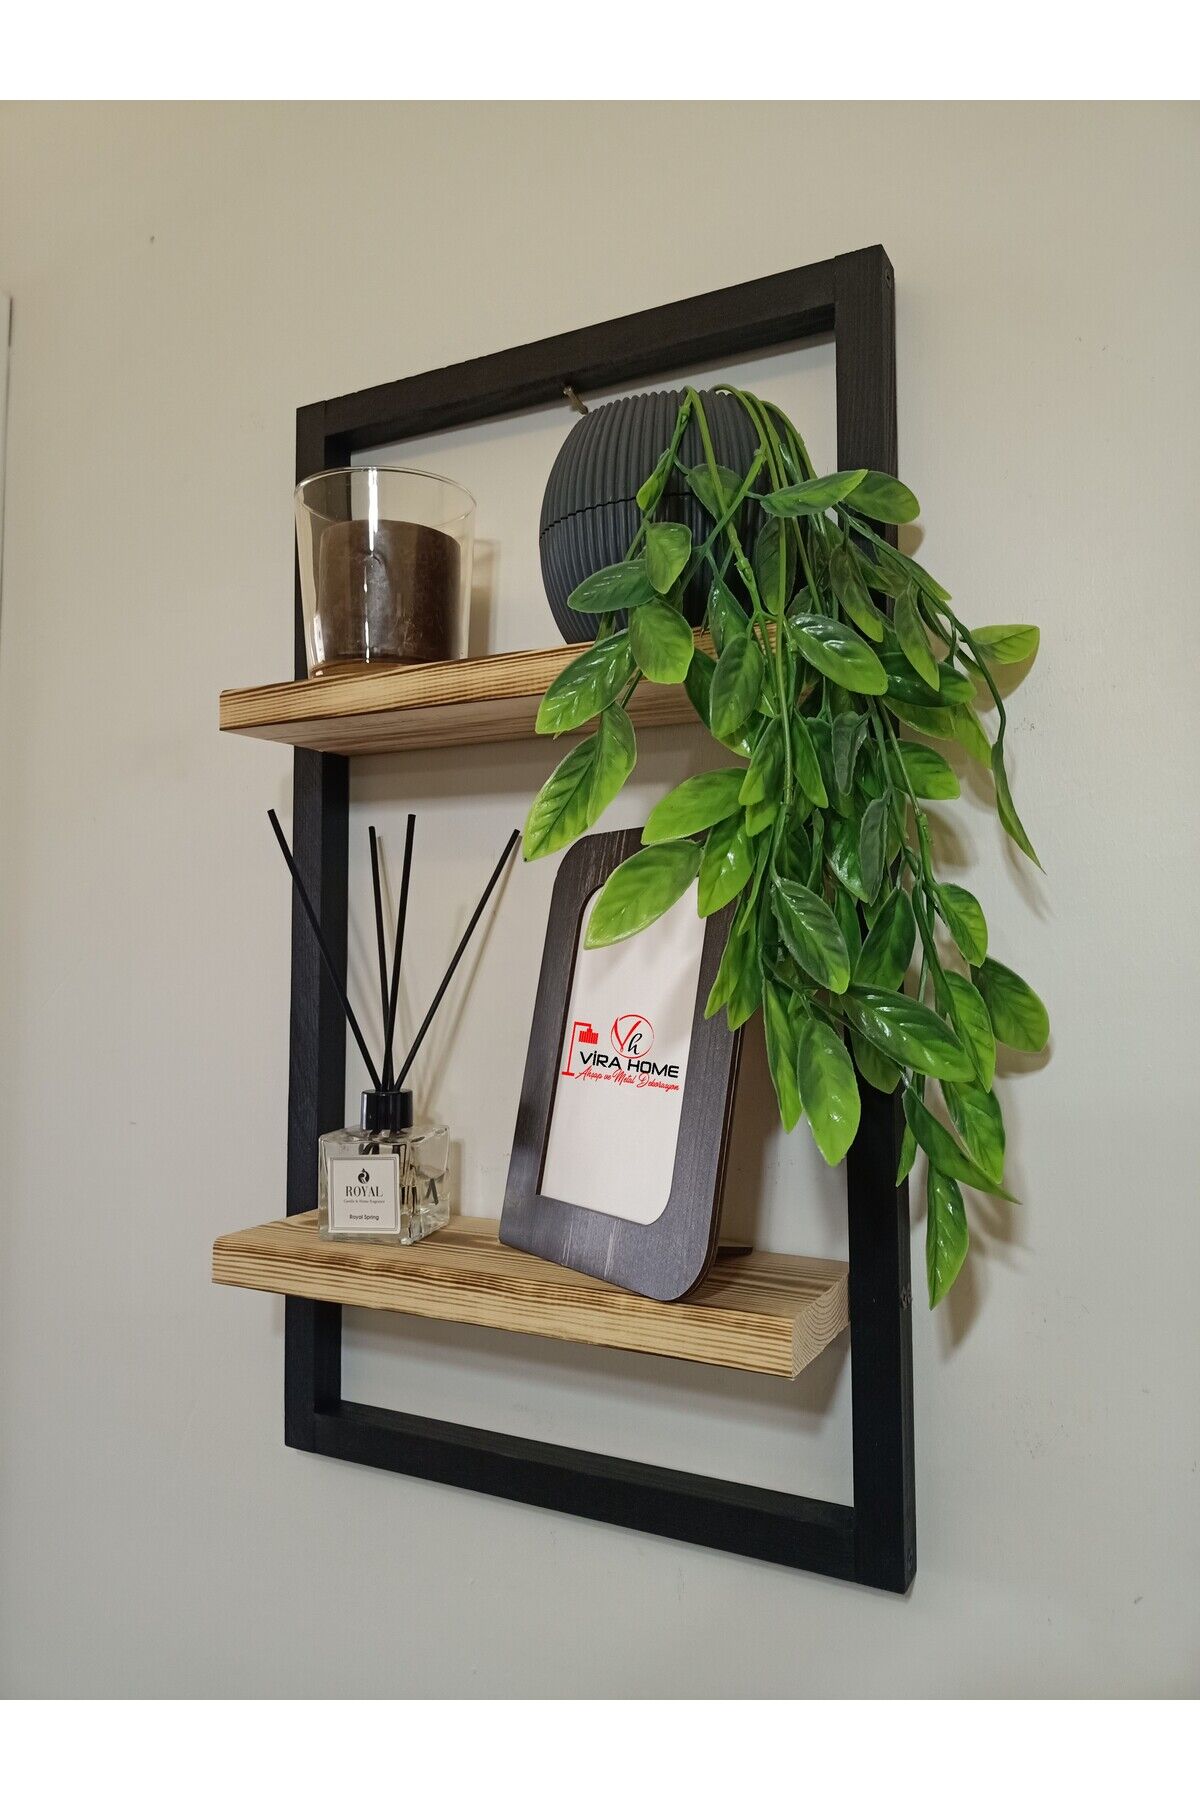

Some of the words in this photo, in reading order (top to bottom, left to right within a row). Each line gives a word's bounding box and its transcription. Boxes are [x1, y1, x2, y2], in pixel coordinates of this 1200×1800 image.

[579, 1050, 622, 1070] VİRA
[627, 1059, 680, 1079] HOME
[612, 1068, 635, 1085] Metal
[345, 1185, 384, 1197] ROYAL
[349, 1213, 363, 1221] Royal
[364, 1213, 380, 1221] Spring
